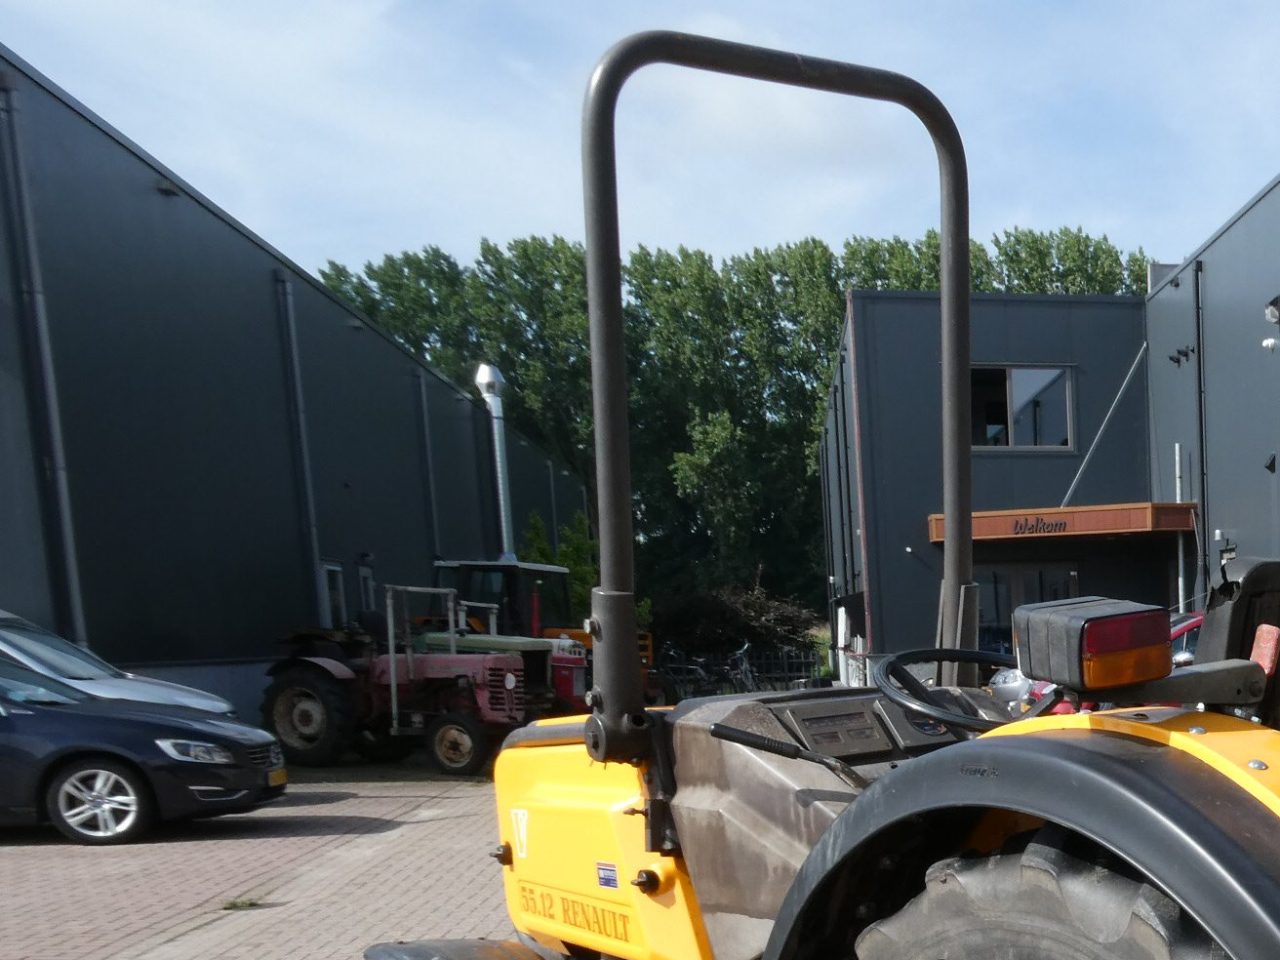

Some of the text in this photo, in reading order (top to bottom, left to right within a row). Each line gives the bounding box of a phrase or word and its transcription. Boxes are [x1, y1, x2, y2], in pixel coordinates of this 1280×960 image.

[1013, 517, 1067, 535] Welkom
[521, 887, 630, 943] 55.12 RENAULT
